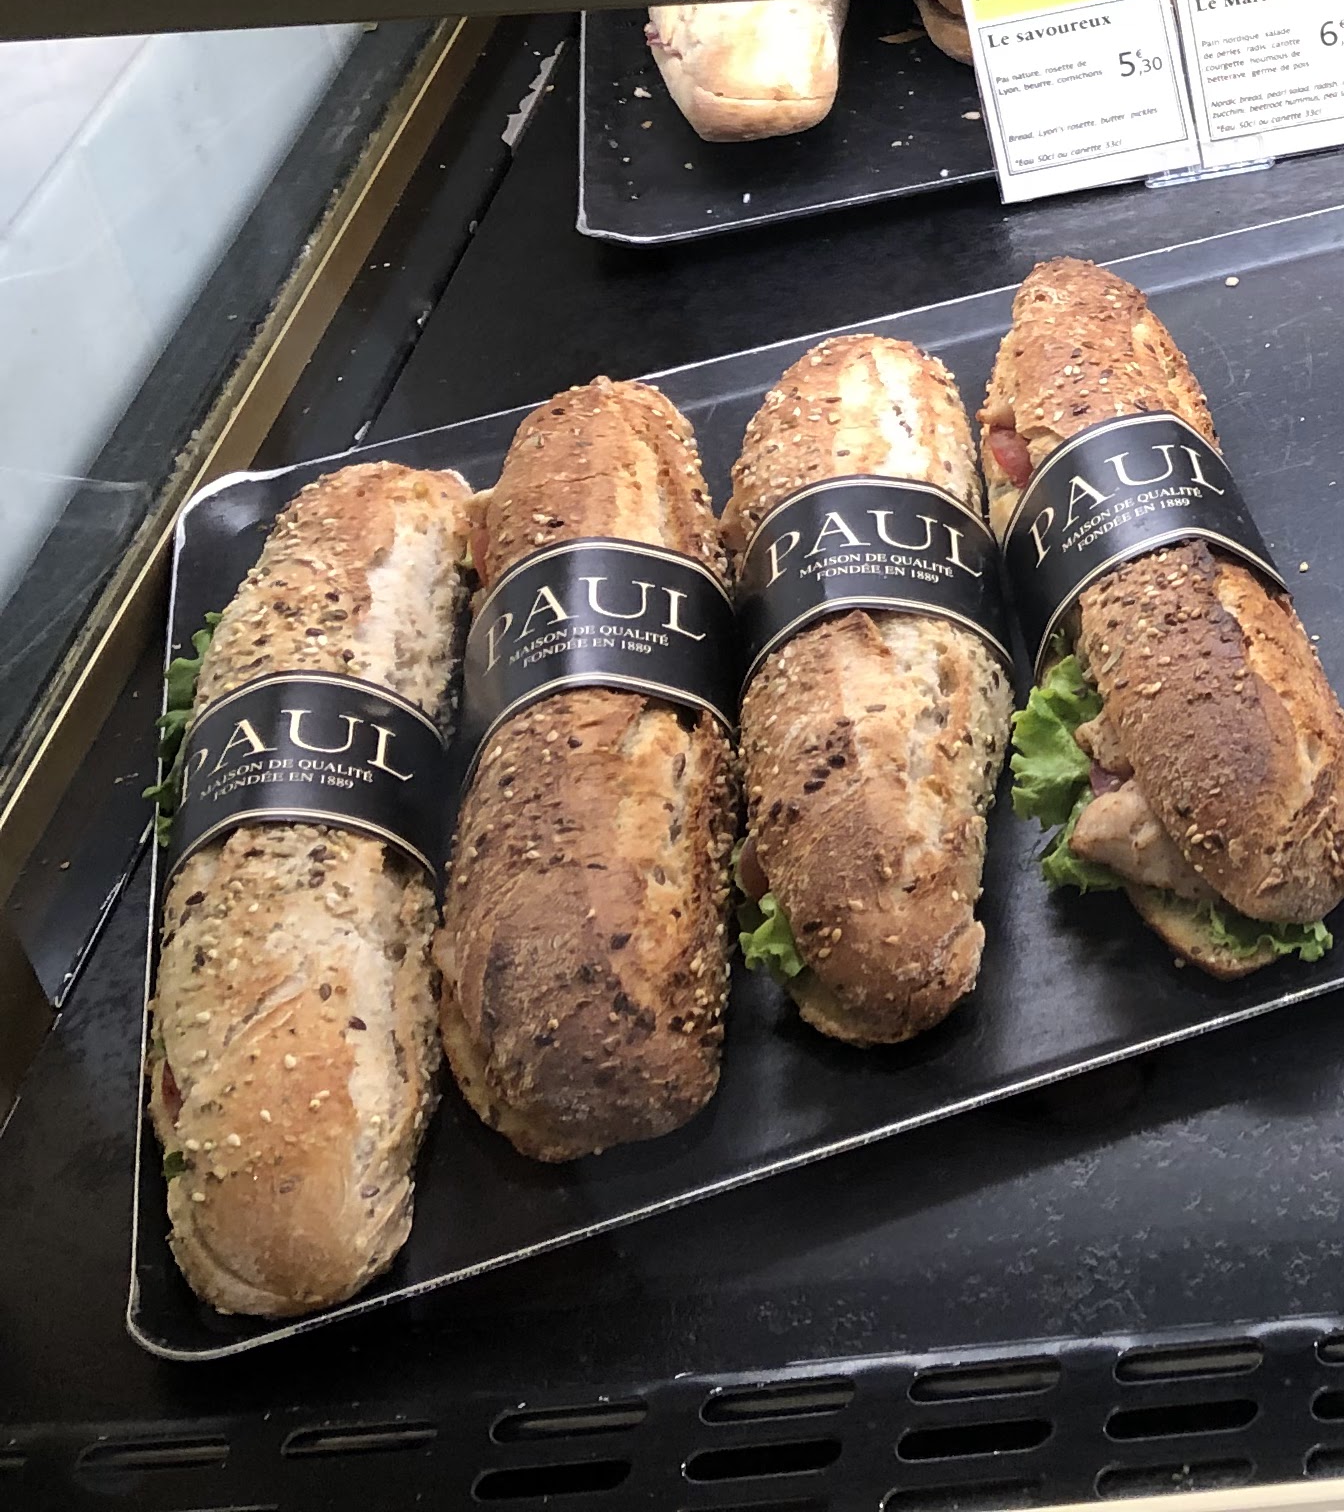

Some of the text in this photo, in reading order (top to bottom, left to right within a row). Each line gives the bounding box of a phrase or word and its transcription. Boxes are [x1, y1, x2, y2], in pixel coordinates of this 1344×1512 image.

[988, 14, 1112, 48] Le savoureux
[1028, 444, 1224, 569] PAUL
[1061, 487, 1203, 553] MAISON DE QUALITÉ
[1077, 498, 1190, 552] FONDÉE EN 1889
[766, 510, 982, 588] PAUL
[799, 553, 954, 578] MAISON DE QUALITÉ
[816, 564, 939, 583] FONDÉE EN 1889
[482, 576, 706, 677] PAUL
[509, 625, 669, 665] MAISON DE QUALITÉ
[523, 637, 652, 669] FONDÉE EN 1889
[178, 709, 416, 812] PAUL
